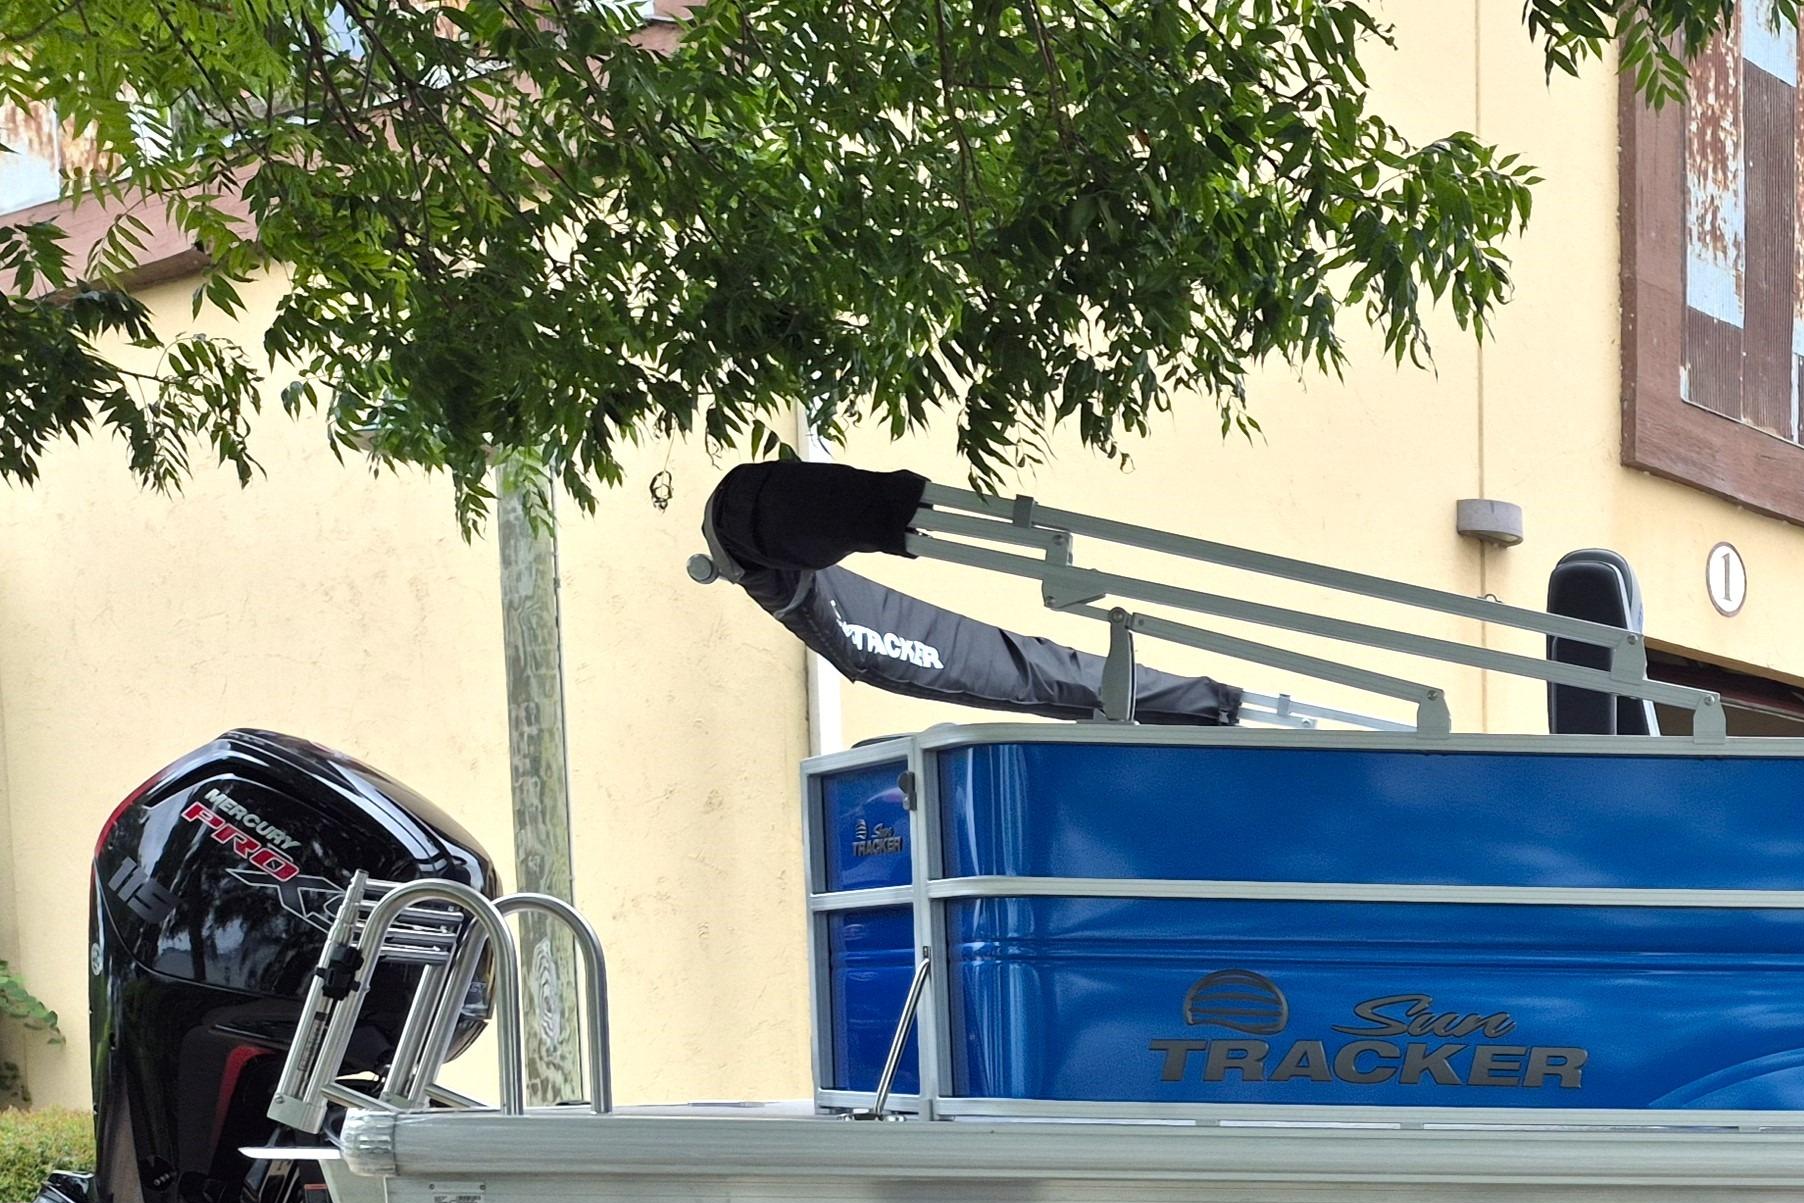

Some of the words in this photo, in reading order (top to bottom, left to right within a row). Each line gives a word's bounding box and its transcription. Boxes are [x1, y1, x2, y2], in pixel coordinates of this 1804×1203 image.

[181, 801, 300, 882] PRO
[204, 788, 300, 849] MERCURY
[852, 836, 902, 856] TRACKER
[107, 856, 179, 925] 115
[1331, 994, 1516, 1038] Sun
[1148, 1038, 1588, 1089] TRACKER
